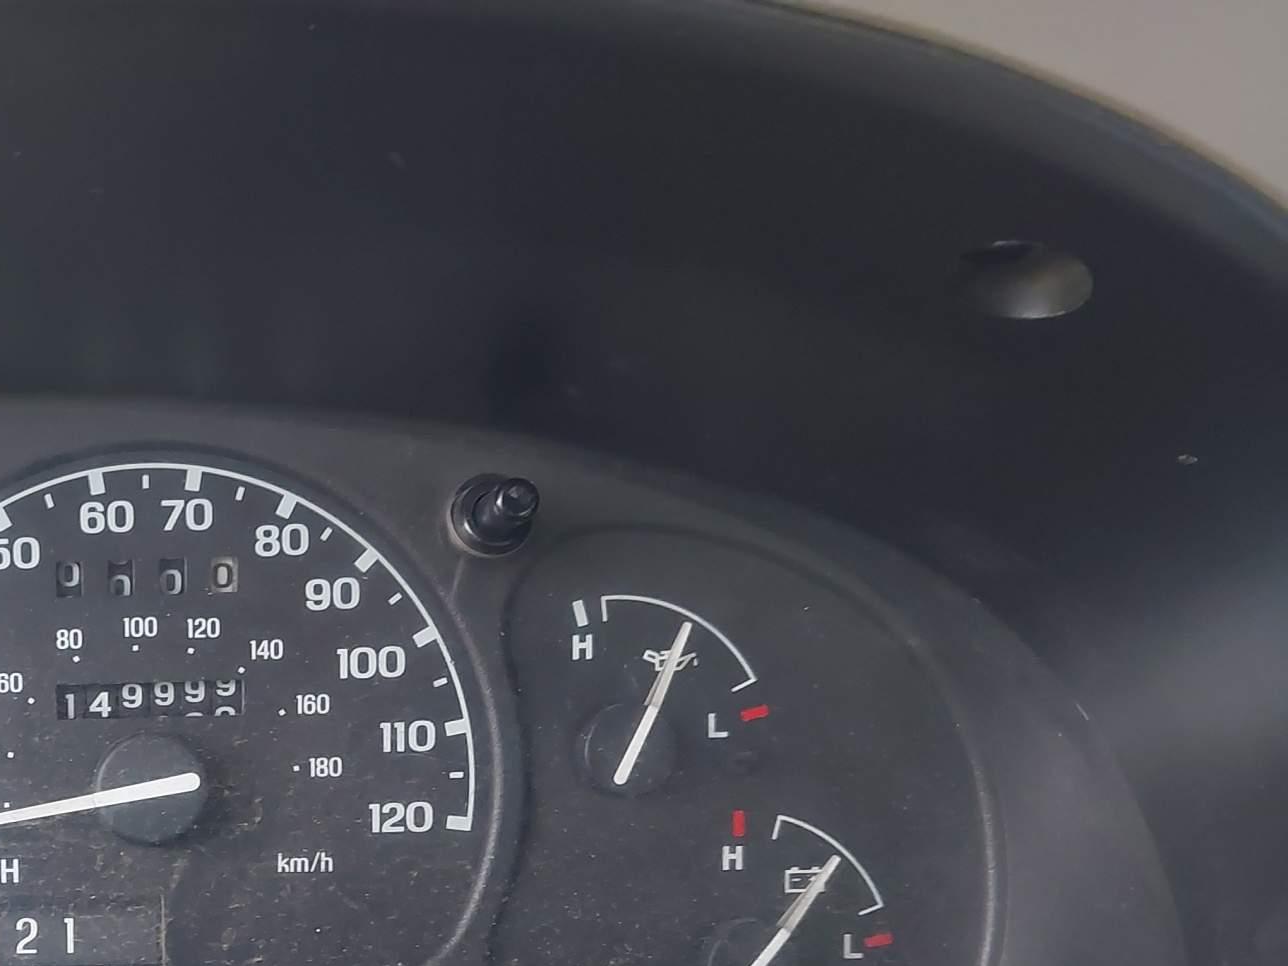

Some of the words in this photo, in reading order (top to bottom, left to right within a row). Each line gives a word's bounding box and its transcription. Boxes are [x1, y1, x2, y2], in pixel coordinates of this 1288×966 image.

[79, 501, 135, 534] 60
[161, 500, 214, 532] 70
[254, 524, 309, 557] 80
[304, 577, 360, 611] 90
[56, 629, 83, 650] 80
[122, 616, 158, 637] 100
[187, 617, 220, 639] 120
[249, 639, 283, 660] 140
[572, 634, 593, 661] H
[337, 645, 406, 680] 100
[295, 694, 330, 715] 160
[379, 719, 435, 753] 110
[708, 712, 729, 738] L
[309, 757, 343, 778] 180
[368, 801, 434, 834] 120
[277, 852, 334, 874] km/h
[721, 846, 743, 871] H
[15, 917, 38, 954] 2
[843, 934, 863, 959] L
